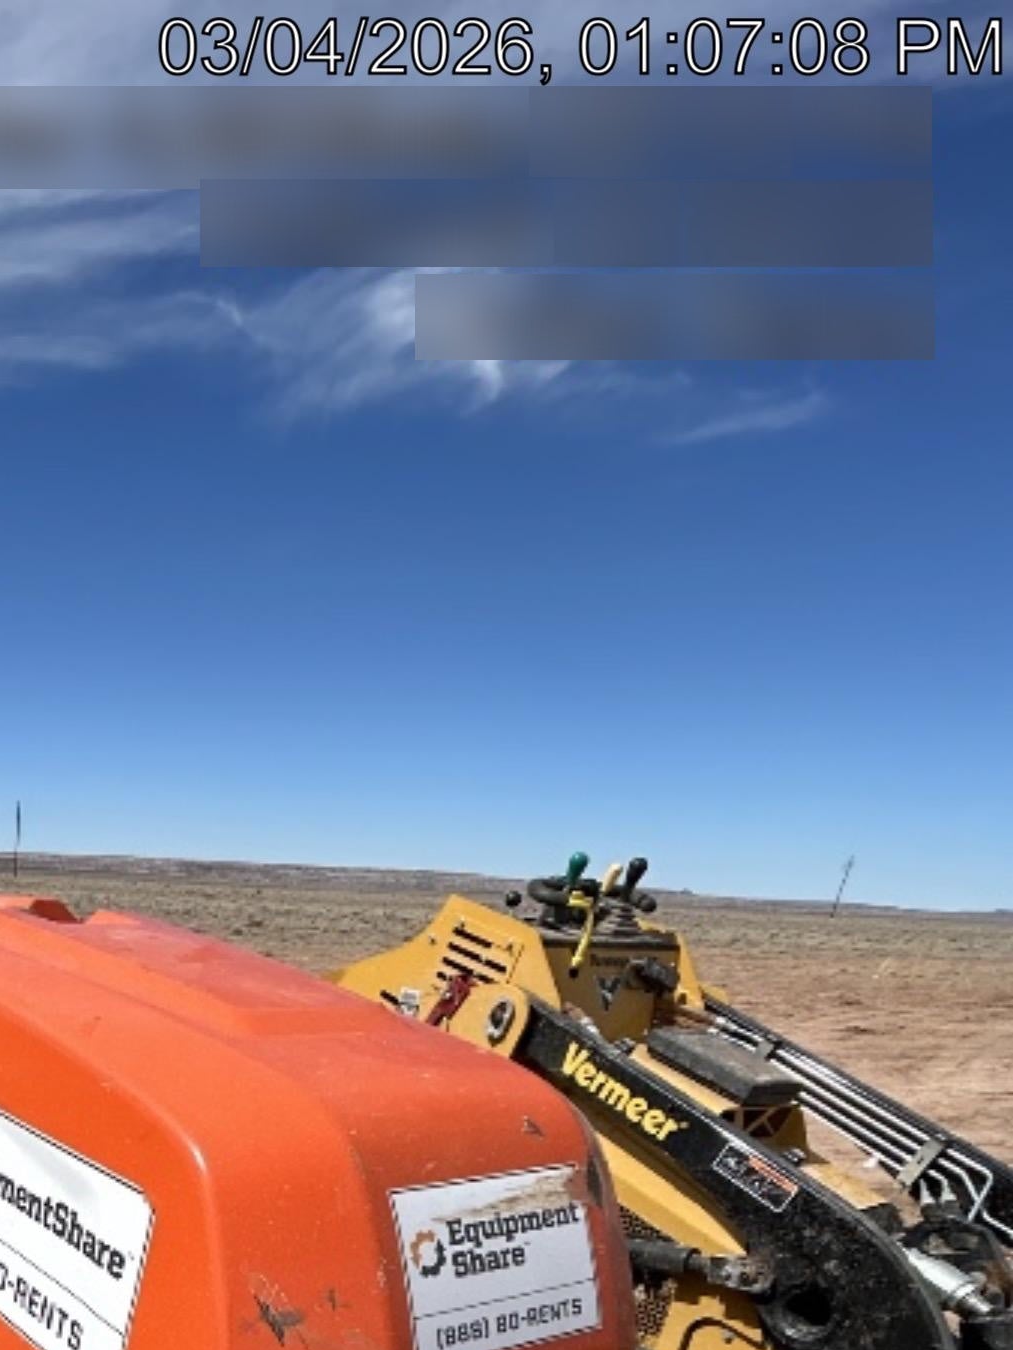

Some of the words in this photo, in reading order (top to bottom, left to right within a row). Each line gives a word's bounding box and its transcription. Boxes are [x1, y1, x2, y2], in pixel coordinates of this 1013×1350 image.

[561, 1041, 678, 1141] Vermeer
[446, 1204, 580, 1248] Equipment
[451, 1245, 526, 1278] Share
[496, 1298, 583, 1334] 80-RENTS
